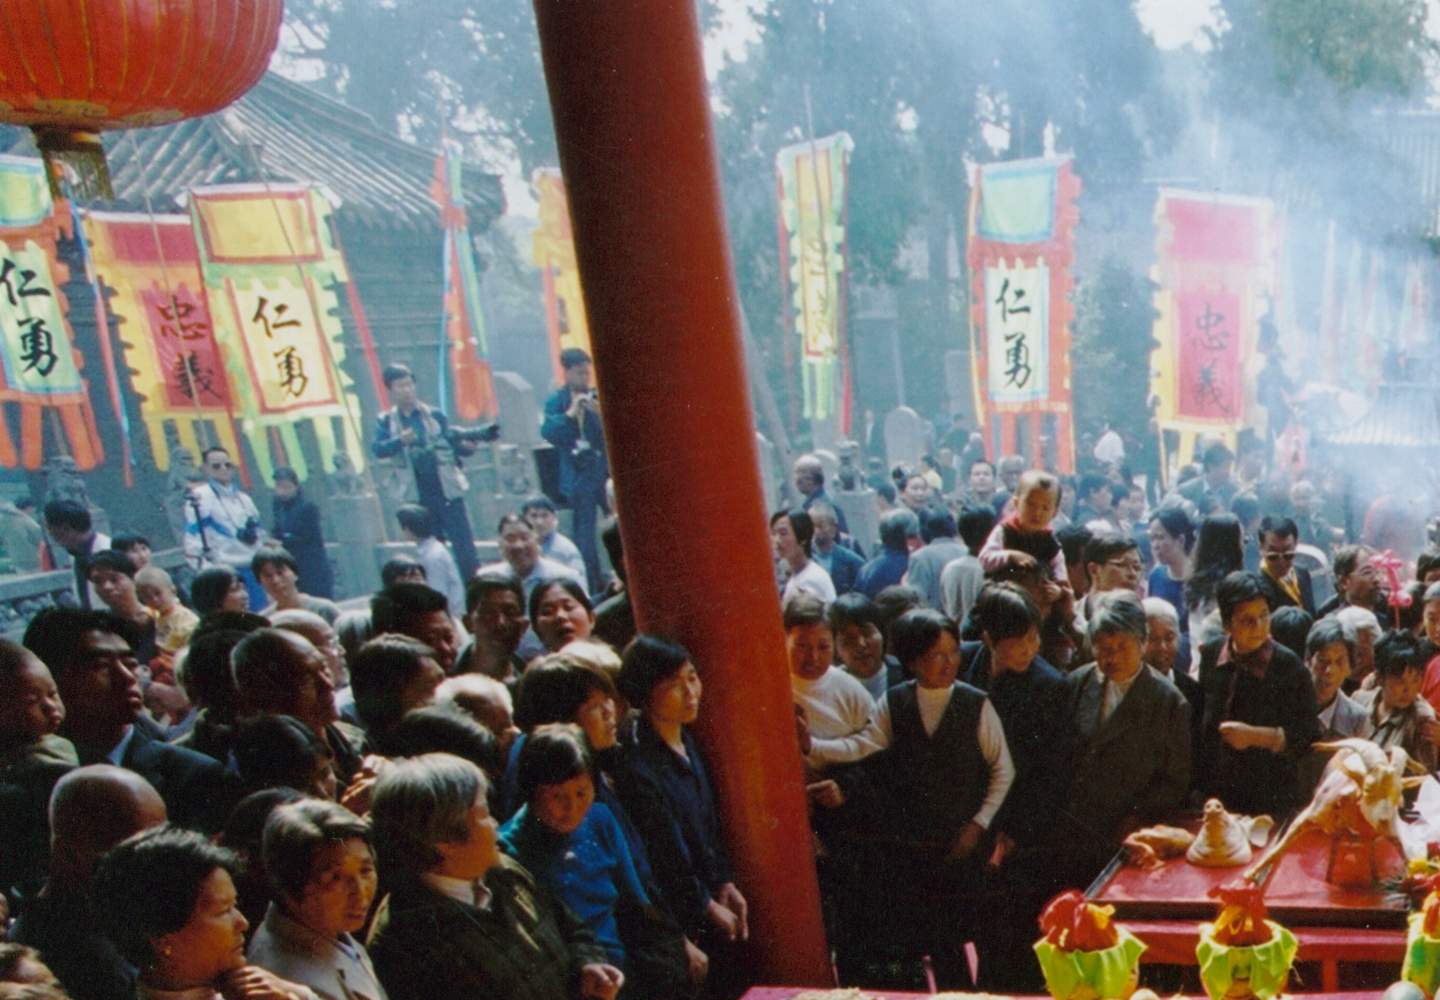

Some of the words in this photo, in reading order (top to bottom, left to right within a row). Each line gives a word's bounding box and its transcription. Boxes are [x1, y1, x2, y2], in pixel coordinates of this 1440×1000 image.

[0, 257, 58, 377] 仁勇
[156, 294, 223, 399] 忠義
[252, 295, 308, 398] 仁勇
[995, 277, 1032, 390] 仁勇
